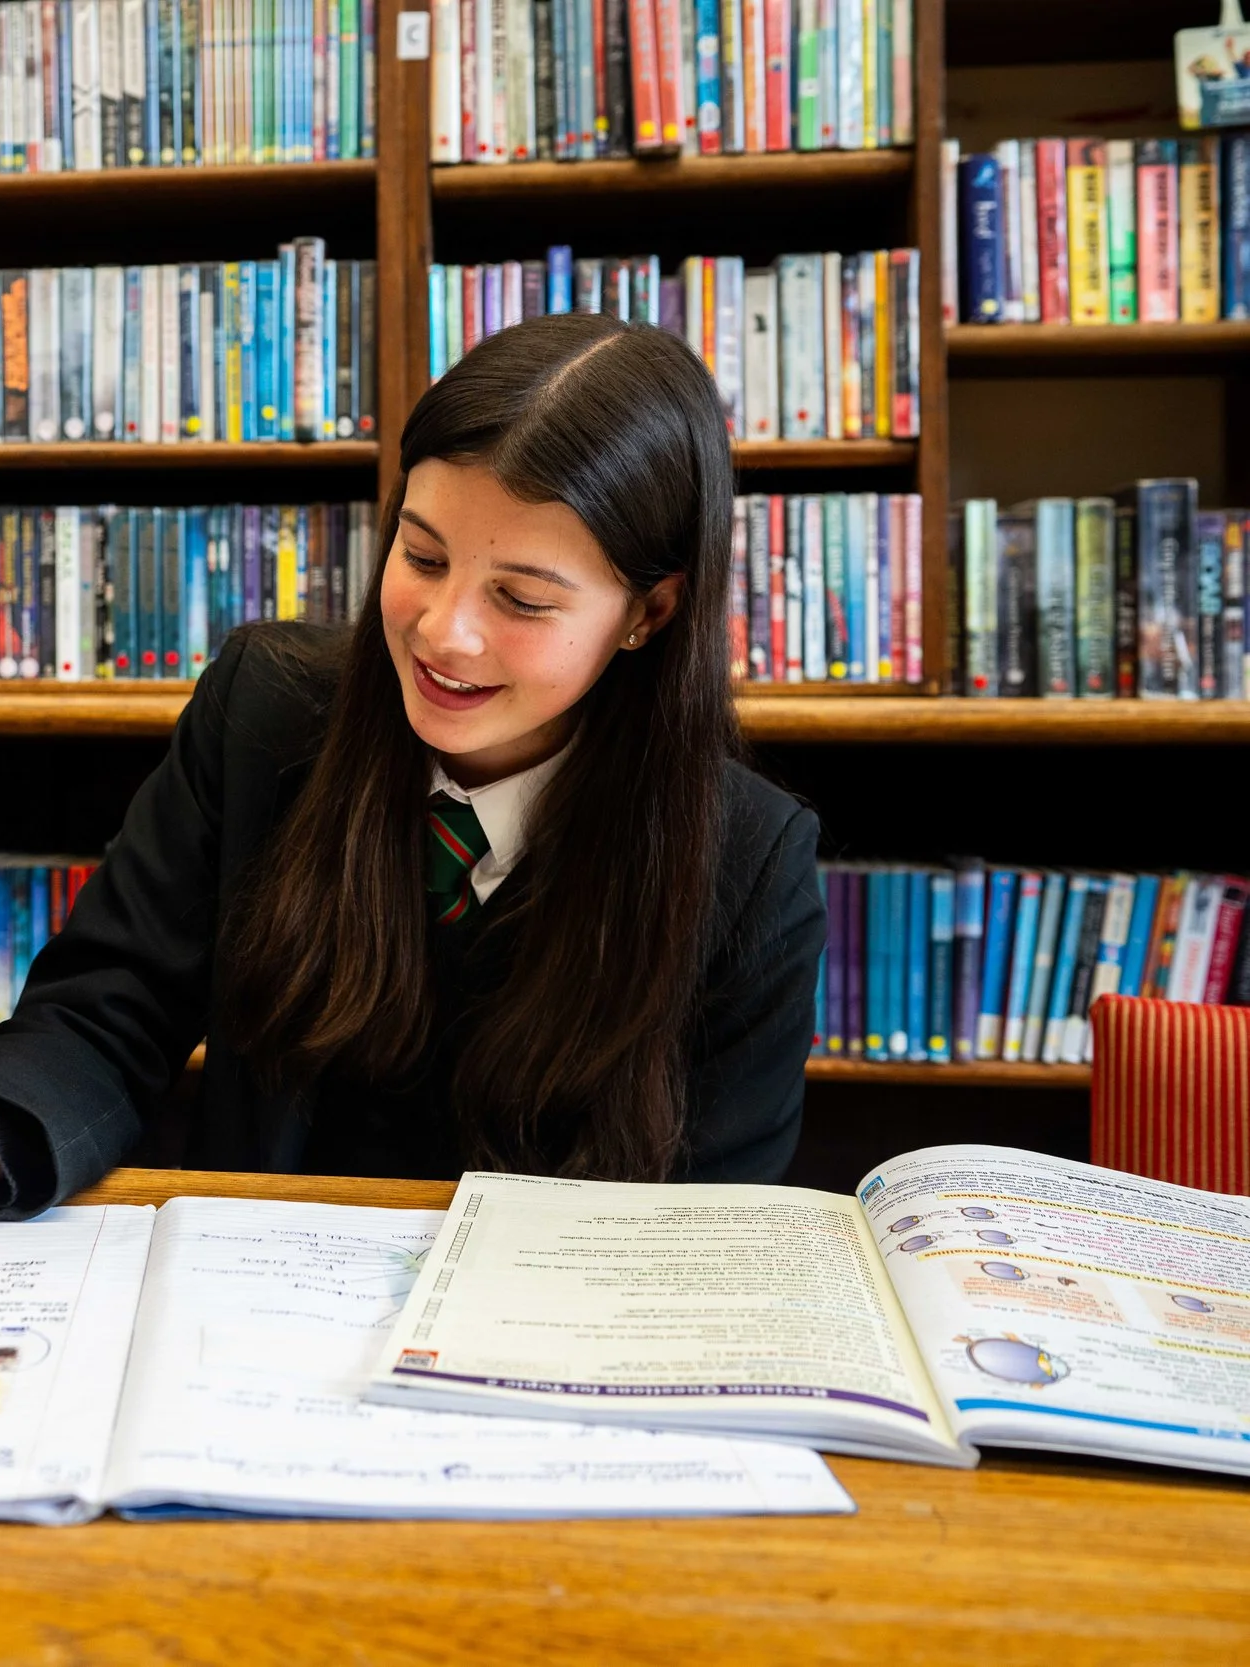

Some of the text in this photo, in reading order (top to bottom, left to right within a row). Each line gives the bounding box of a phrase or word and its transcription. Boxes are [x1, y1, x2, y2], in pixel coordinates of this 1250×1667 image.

[507, 1378, 567, 1393] Topic
[571, 1384, 601, 1395] for
[606, 1385, 720, 1395] Questions
[726, 1385, 826, 1397] Revision
